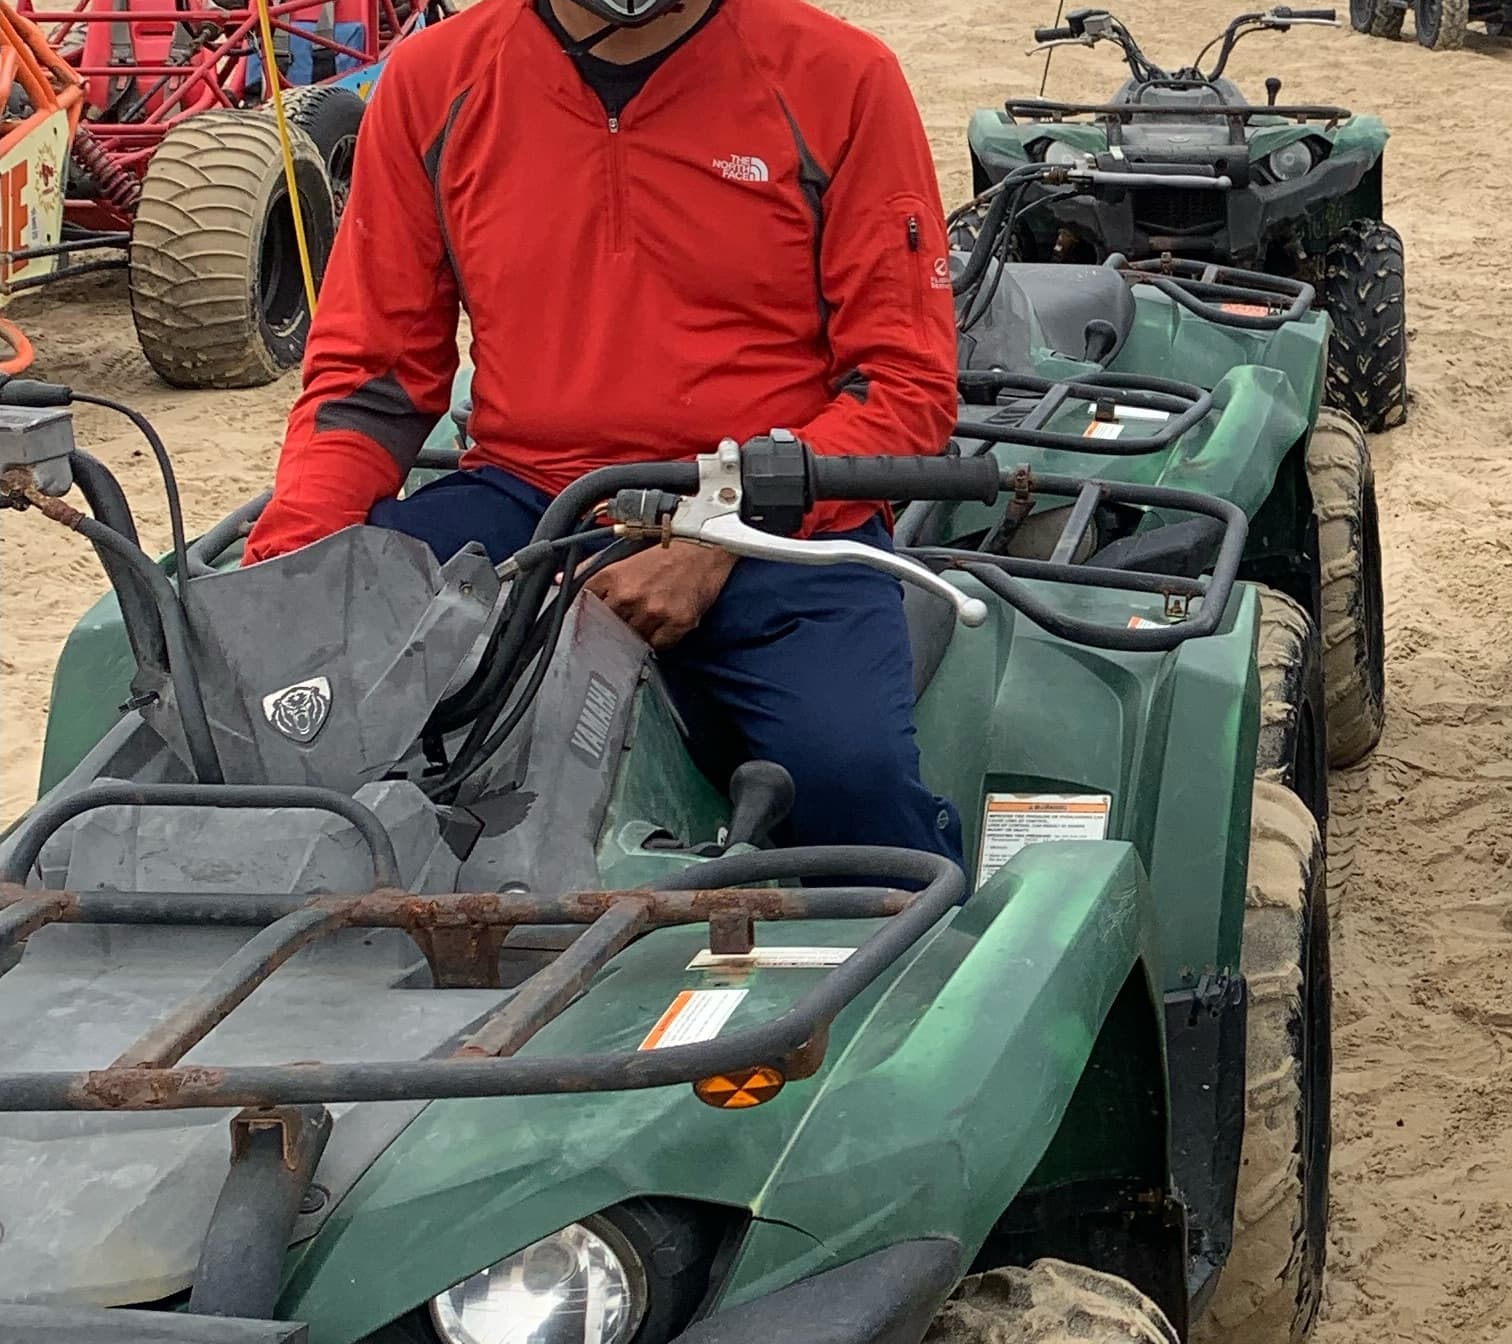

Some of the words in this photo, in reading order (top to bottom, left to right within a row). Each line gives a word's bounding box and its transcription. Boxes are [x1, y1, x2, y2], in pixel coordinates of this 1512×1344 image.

[712, 158, 751, 174] NORTH
[730, 154, 751, 165] THE
[722, 167, 751, 181] FACE
[570, 677, 618, 758] YAMAHA
